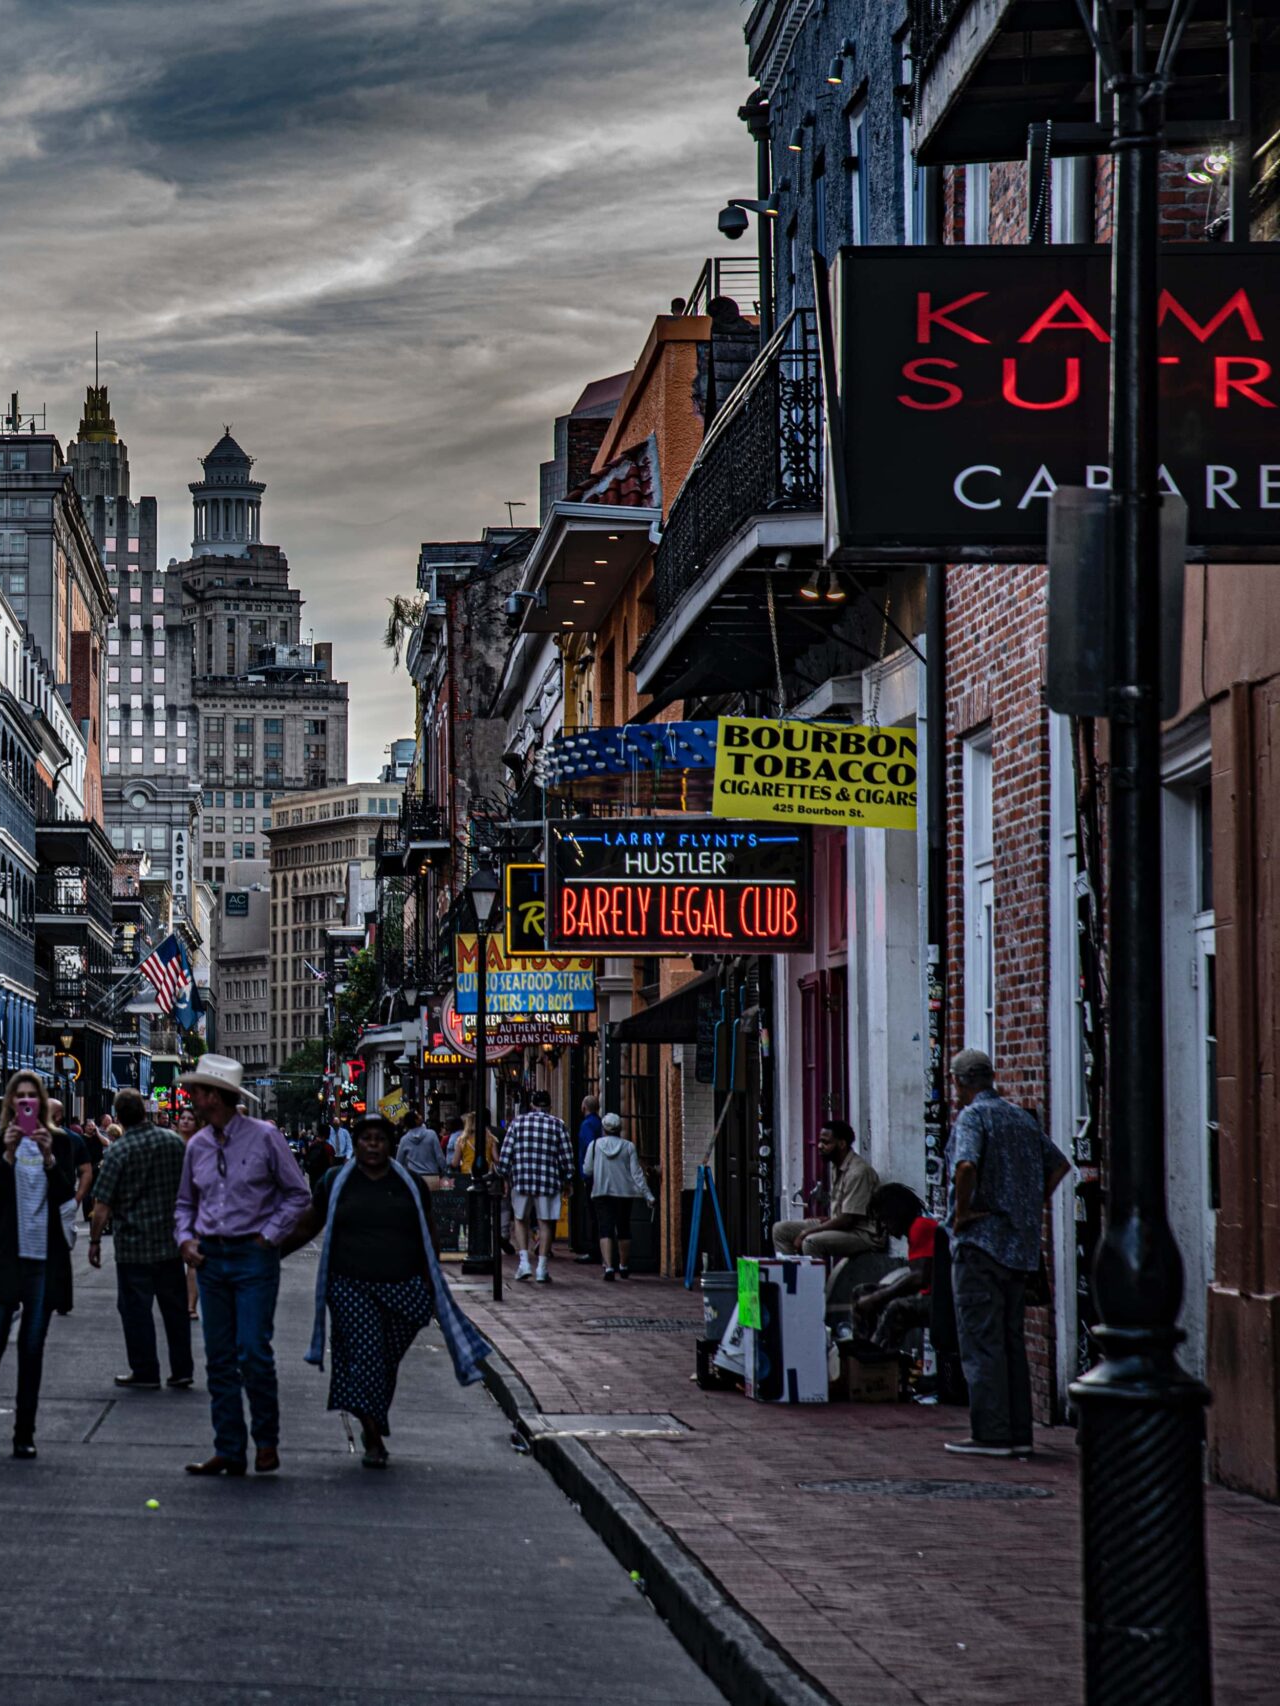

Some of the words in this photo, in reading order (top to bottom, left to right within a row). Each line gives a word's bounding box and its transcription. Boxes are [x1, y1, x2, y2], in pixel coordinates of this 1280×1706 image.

[896, 355, 1279, 411] SUR
[723, 725, 917, 758] BOURBON
[727, 753, 917, 786] TOBACCO
[720, 779, 832, 801] CIGARETTES
[836, 787, 850, 801] &
[855, 788, 917, 807] CIGARS
[772, 803, 794, 813] 425
[798, 805, 845, 817] Bourbon
[849, 808, 865, 818] St.
[603, 832, 666, 846] LARRY
[679, 833, 758, 848] FLYNT'S
[175, 832, 184, 893] ASTOR
[228, 895, 246, 904] AC
[562, 886, 652, 936] BARELY
[660, 885, 733, 937] LEGAL
[740, 886, 798, 937] CLUB
[486, 993, 522, 1012] YSTERS
[464, 1014, 503, 1027] CHKEN
[534, 1012, 570, 1026] SHACK
[500, 1023, 552, 1033] AUTHENTIC
[496, 1034, 540, 1044] ORLEANS
[542, 1033, 580, 1044] CUISINE
